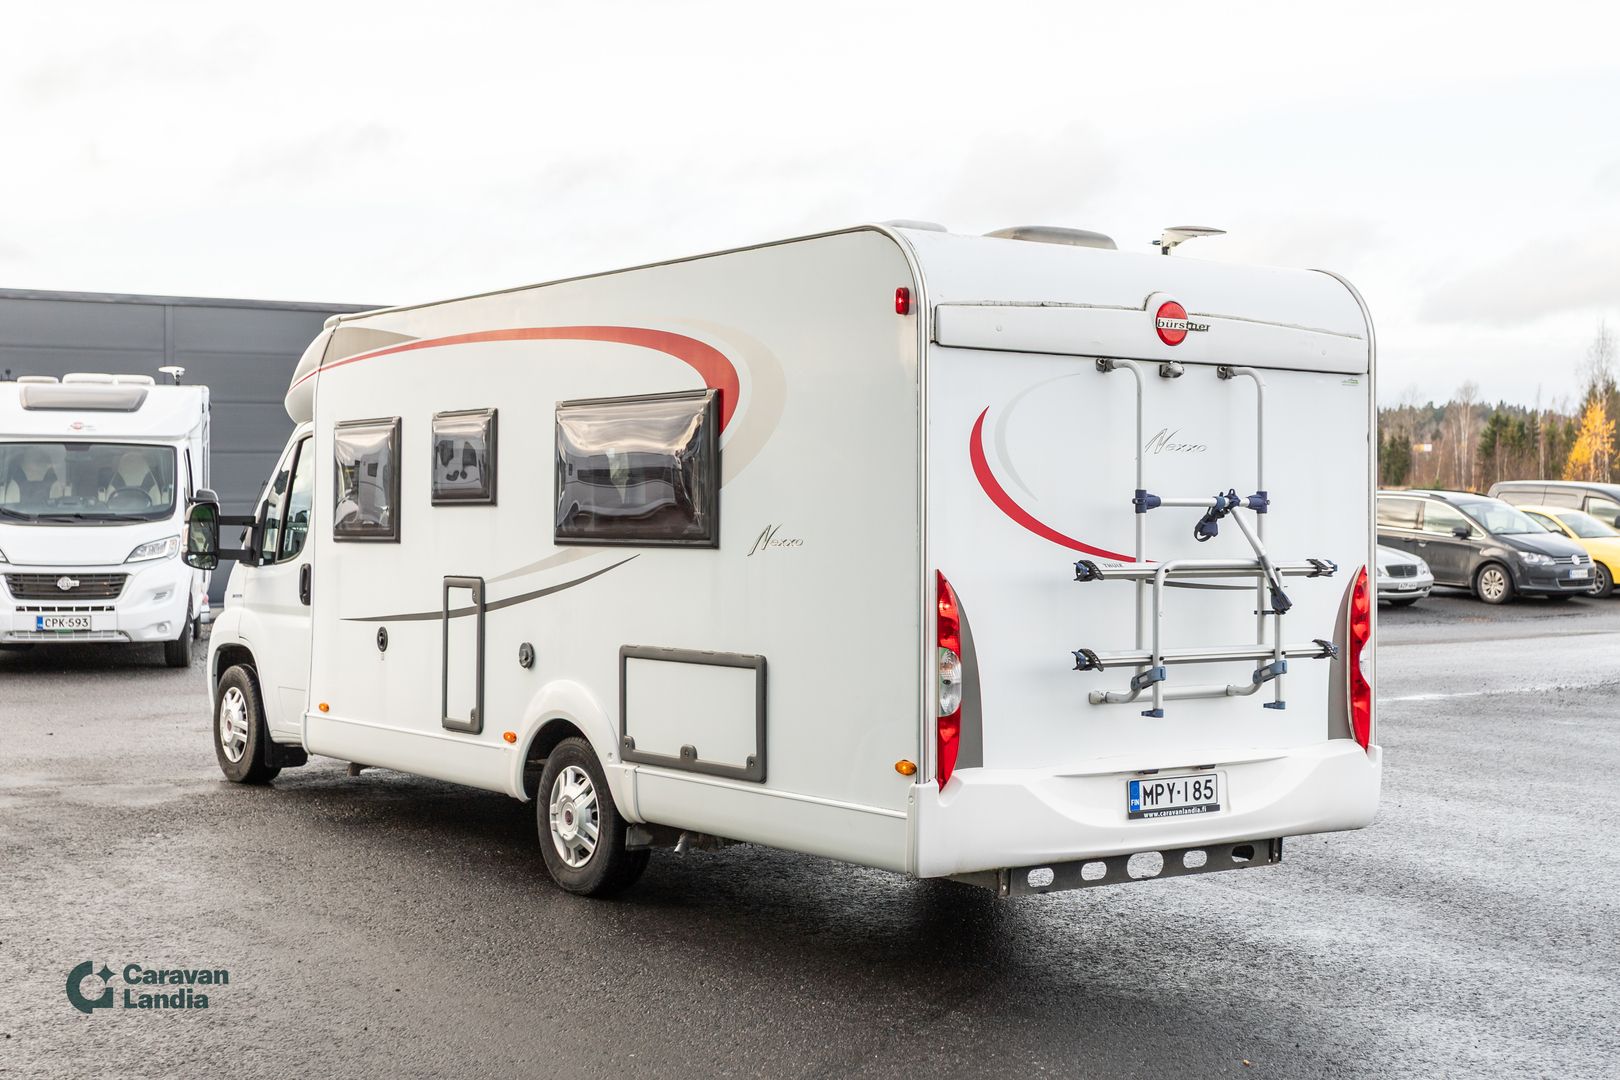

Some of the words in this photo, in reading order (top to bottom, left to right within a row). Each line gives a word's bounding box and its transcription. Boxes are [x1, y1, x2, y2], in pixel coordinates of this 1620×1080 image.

[1157, 318, 1211, 332] bürstner
[1144, 427, 1207, 454] Nexxo
[747, 523, 803, 556] Nexxo
[45, 618, 88, 627] CPK-593
[1143, 779, 1214, 806] MPY-185
[1130, 799, 1140, 807] FIN
[1143, 806, 1207, 818] www.caravanlandia.fi
